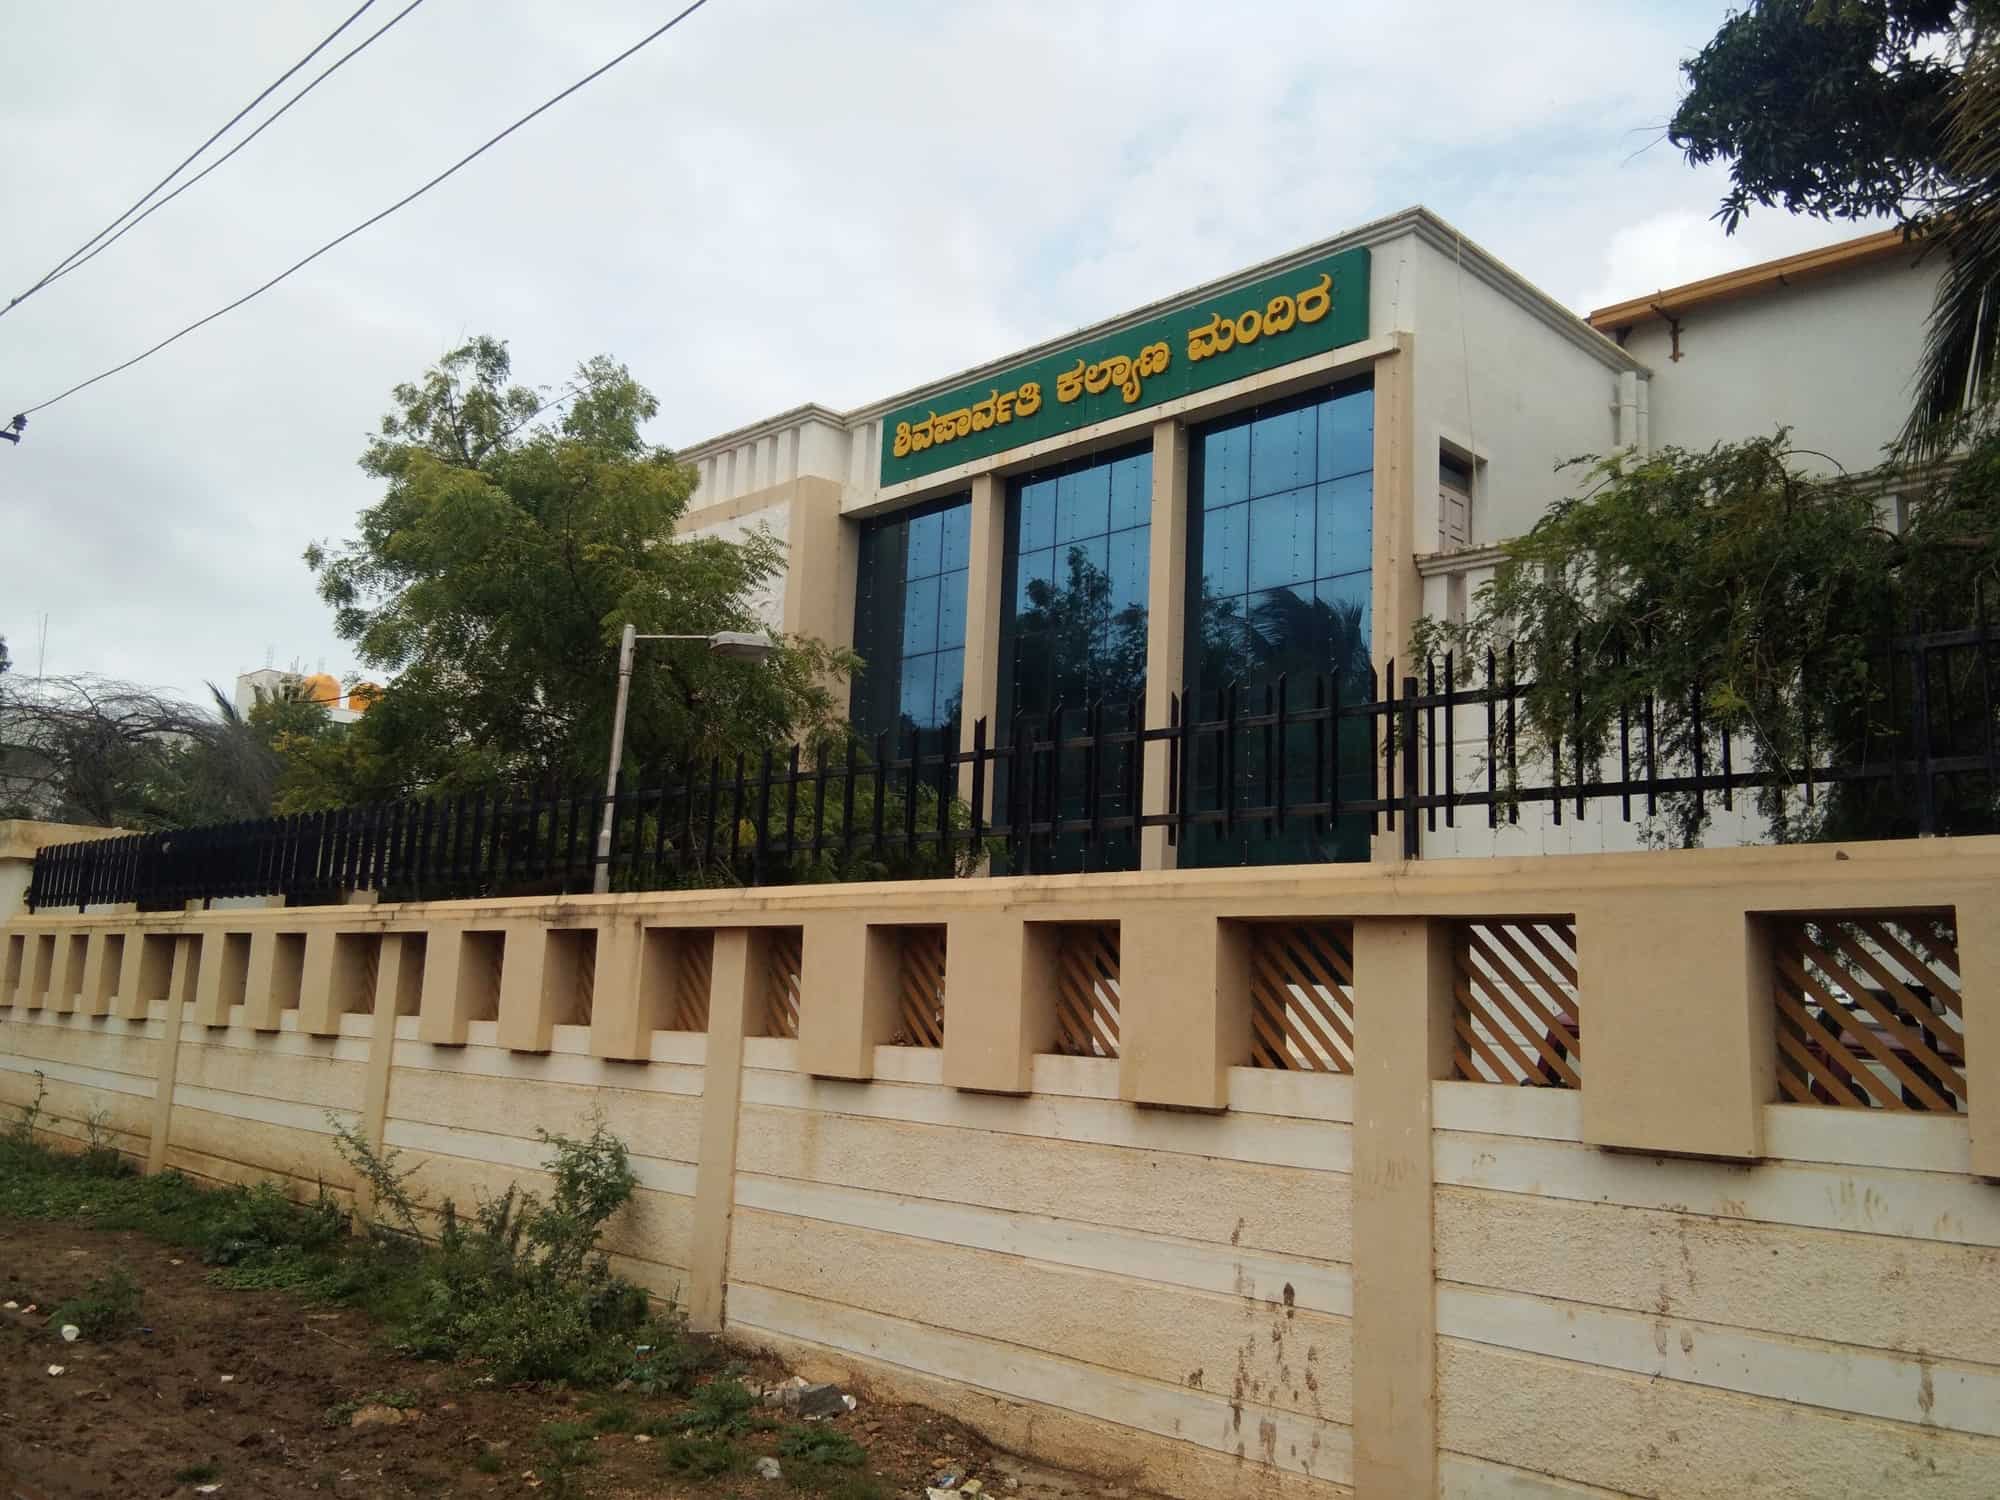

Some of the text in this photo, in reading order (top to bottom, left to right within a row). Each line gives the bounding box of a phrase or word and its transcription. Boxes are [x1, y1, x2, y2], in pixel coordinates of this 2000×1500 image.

[894, 274, 1333, 457] ಶಿವಪಾರ್ವತಿ ಕಲ್ಯಾಣ ಮಂದಿರ
